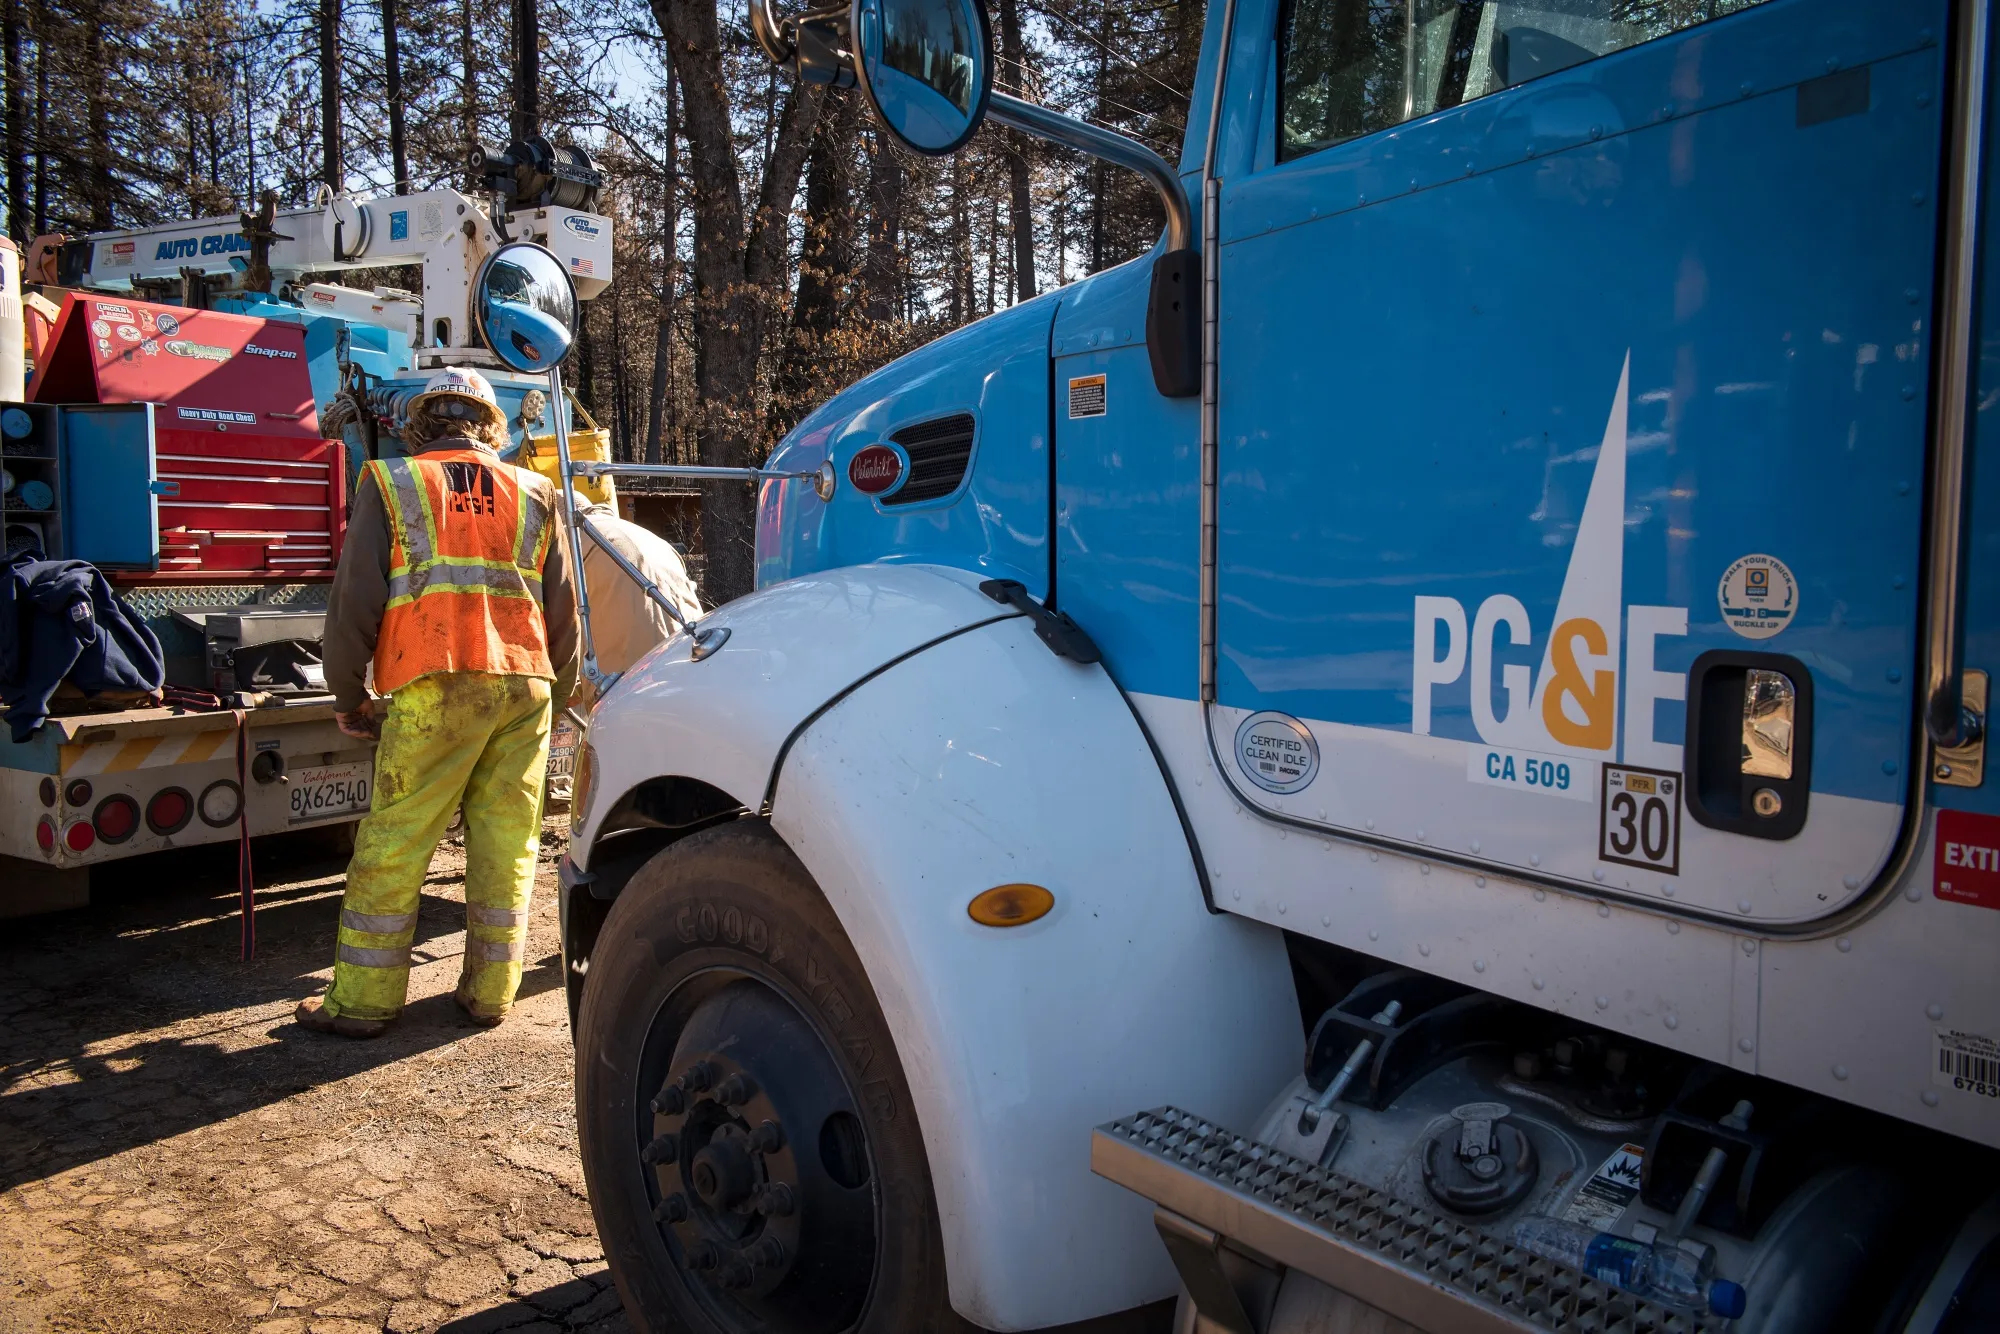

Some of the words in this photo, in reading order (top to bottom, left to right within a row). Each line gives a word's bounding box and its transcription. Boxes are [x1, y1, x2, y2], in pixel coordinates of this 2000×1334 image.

[570, 217, 590, 227] AUTO
[575, 225, 600, 235] CRANE
[155, 237, 198, 260] AUTO
[200, 233, 252, 256] CRAN
[99, 303, 128, 314] LINCOLN
[244, 343, 297, 359] Snap-on
[180, 408, 200, 419] Heavy
[201, 410, 217, 420] Duty
[218, 411, 234, 421] Road
[235, 413, 254, 422] Chest
[853, 456, 894, 482] Peterbilt
[1723, 563, 1743, 583] WALK
[1743, 556, 1767, 565] YOUR
[1769, 559, 1793, 585] TRUCK
[1733, 620, 1766, 628] BUCKLE
[1767, 621, 1779, 629] UP
[1412, 594, 1689, 773] PG&E
[1250, 734, 1302, 752] CERTIFIED
[1245, 747, 1280, 762] CLEAN
[1283, 753, 1307, 767] IDLE
[303, 769, 357, 786] California
[1486, 752, 1516, 782] CA
[1525, 759, 1571, 790] 509
[1612, 771, 1621, 779] CA
[1610, 779, 1623, 787] DMV
[1632, 778, 1650, 790] PFR
[291, 780, 367, 812] 8X62540
[1610, 791, 1669, 861] 30
[1953, 1076, 2000, 1098] 6783
